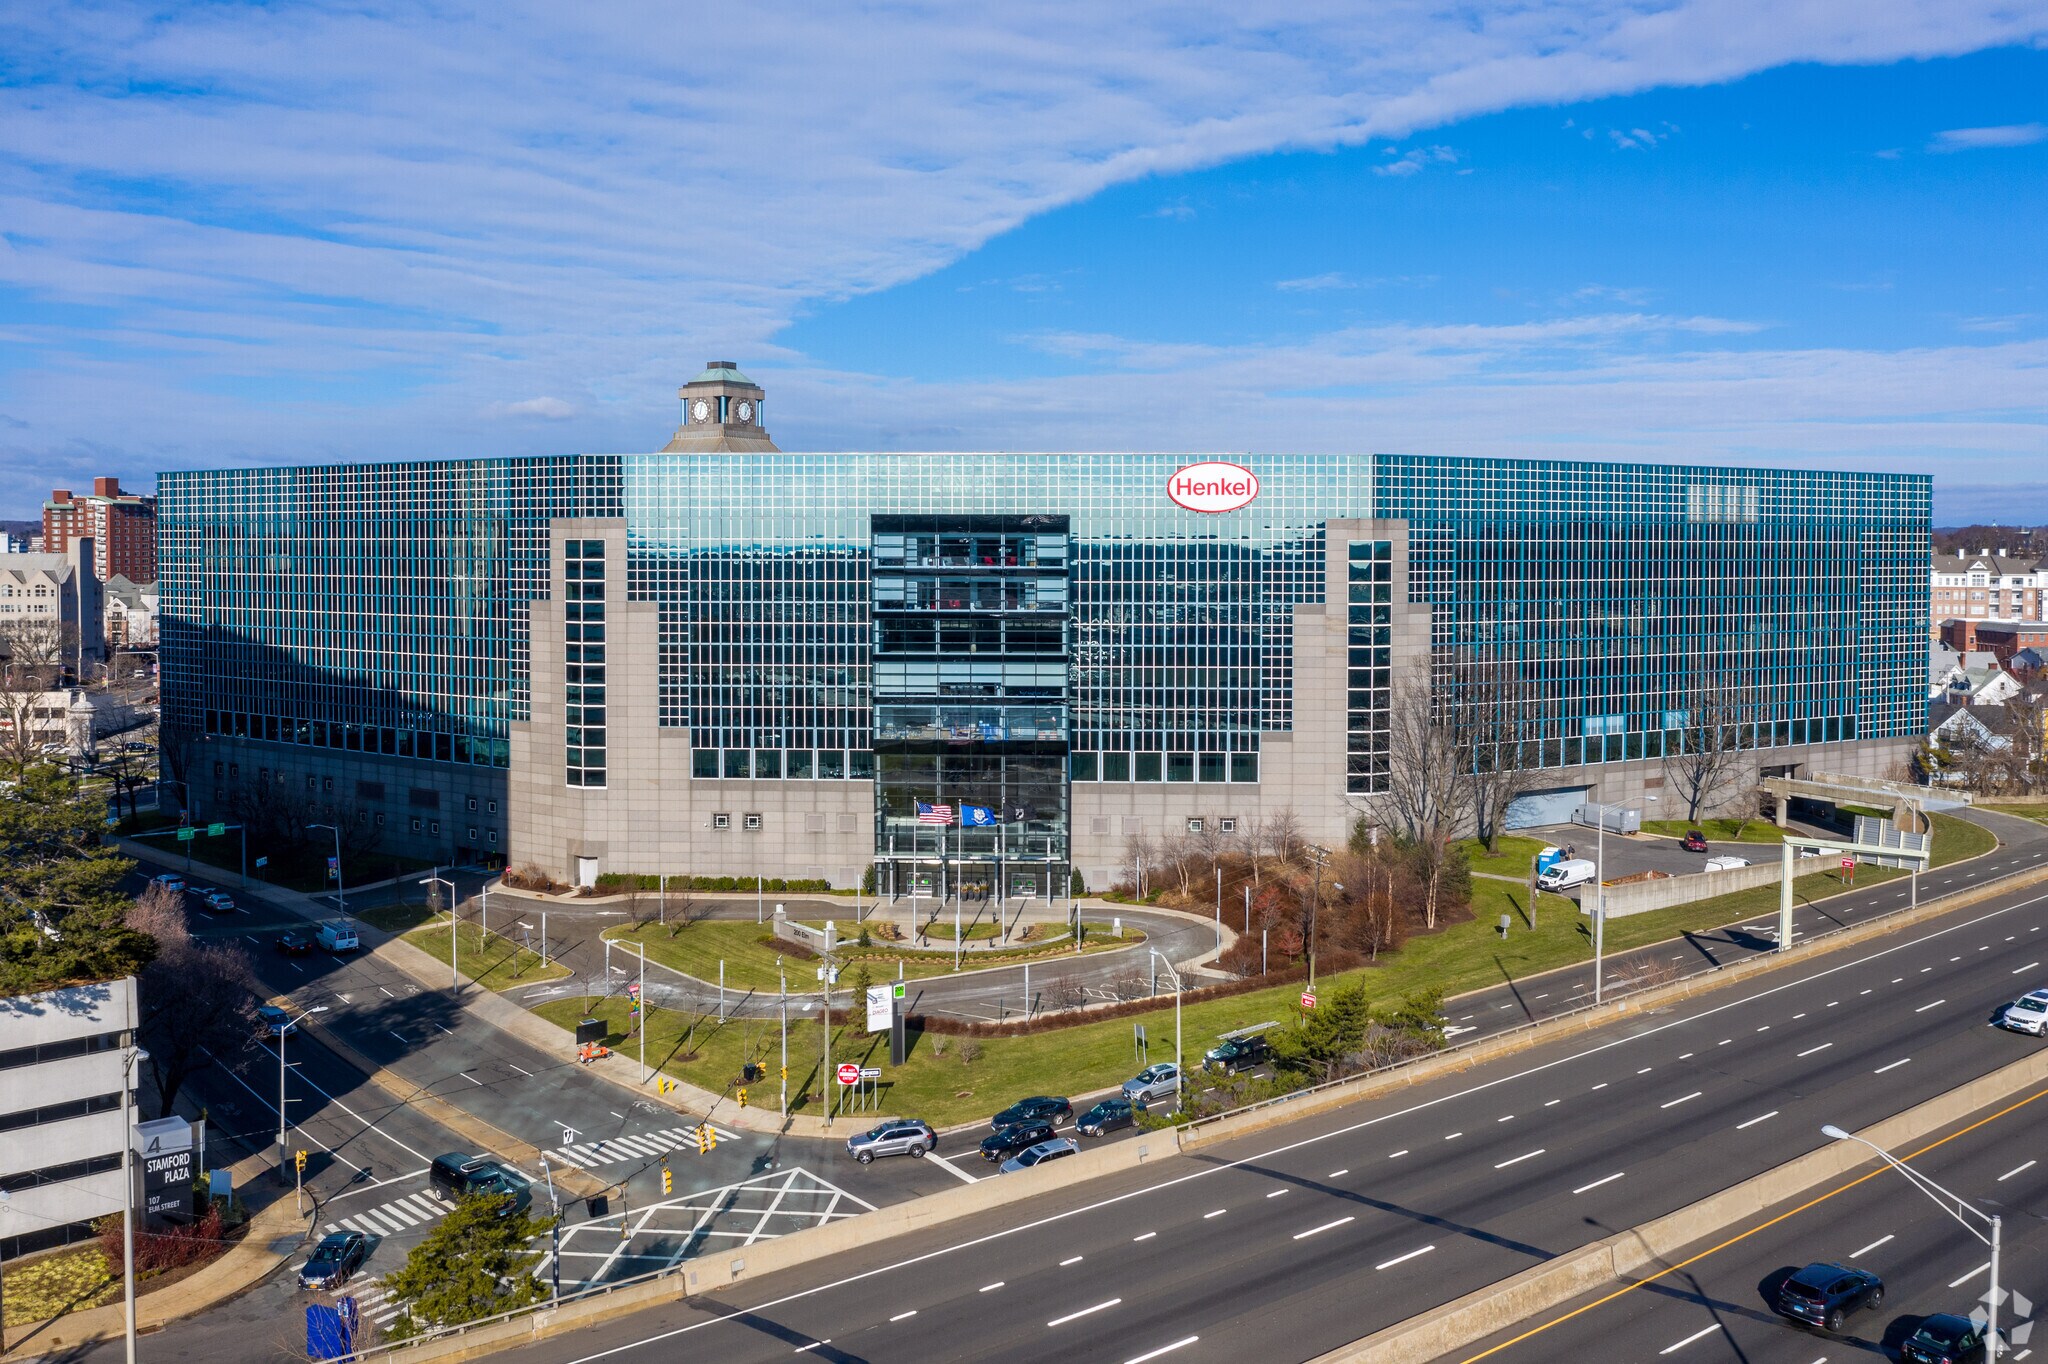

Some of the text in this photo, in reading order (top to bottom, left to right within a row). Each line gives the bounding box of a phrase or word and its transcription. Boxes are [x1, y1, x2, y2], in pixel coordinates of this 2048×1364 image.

[1176, 478, 1251, 496] Henkel
[147, 1136, 161, 1153] 4
[147, 1153, 190, 1173] STAMFORD
[165, 1167, 190, 1183] PLAZA
[148, 1200, 180, 1213] ELM STREET
[149, 1196, 160, 1205] 107
